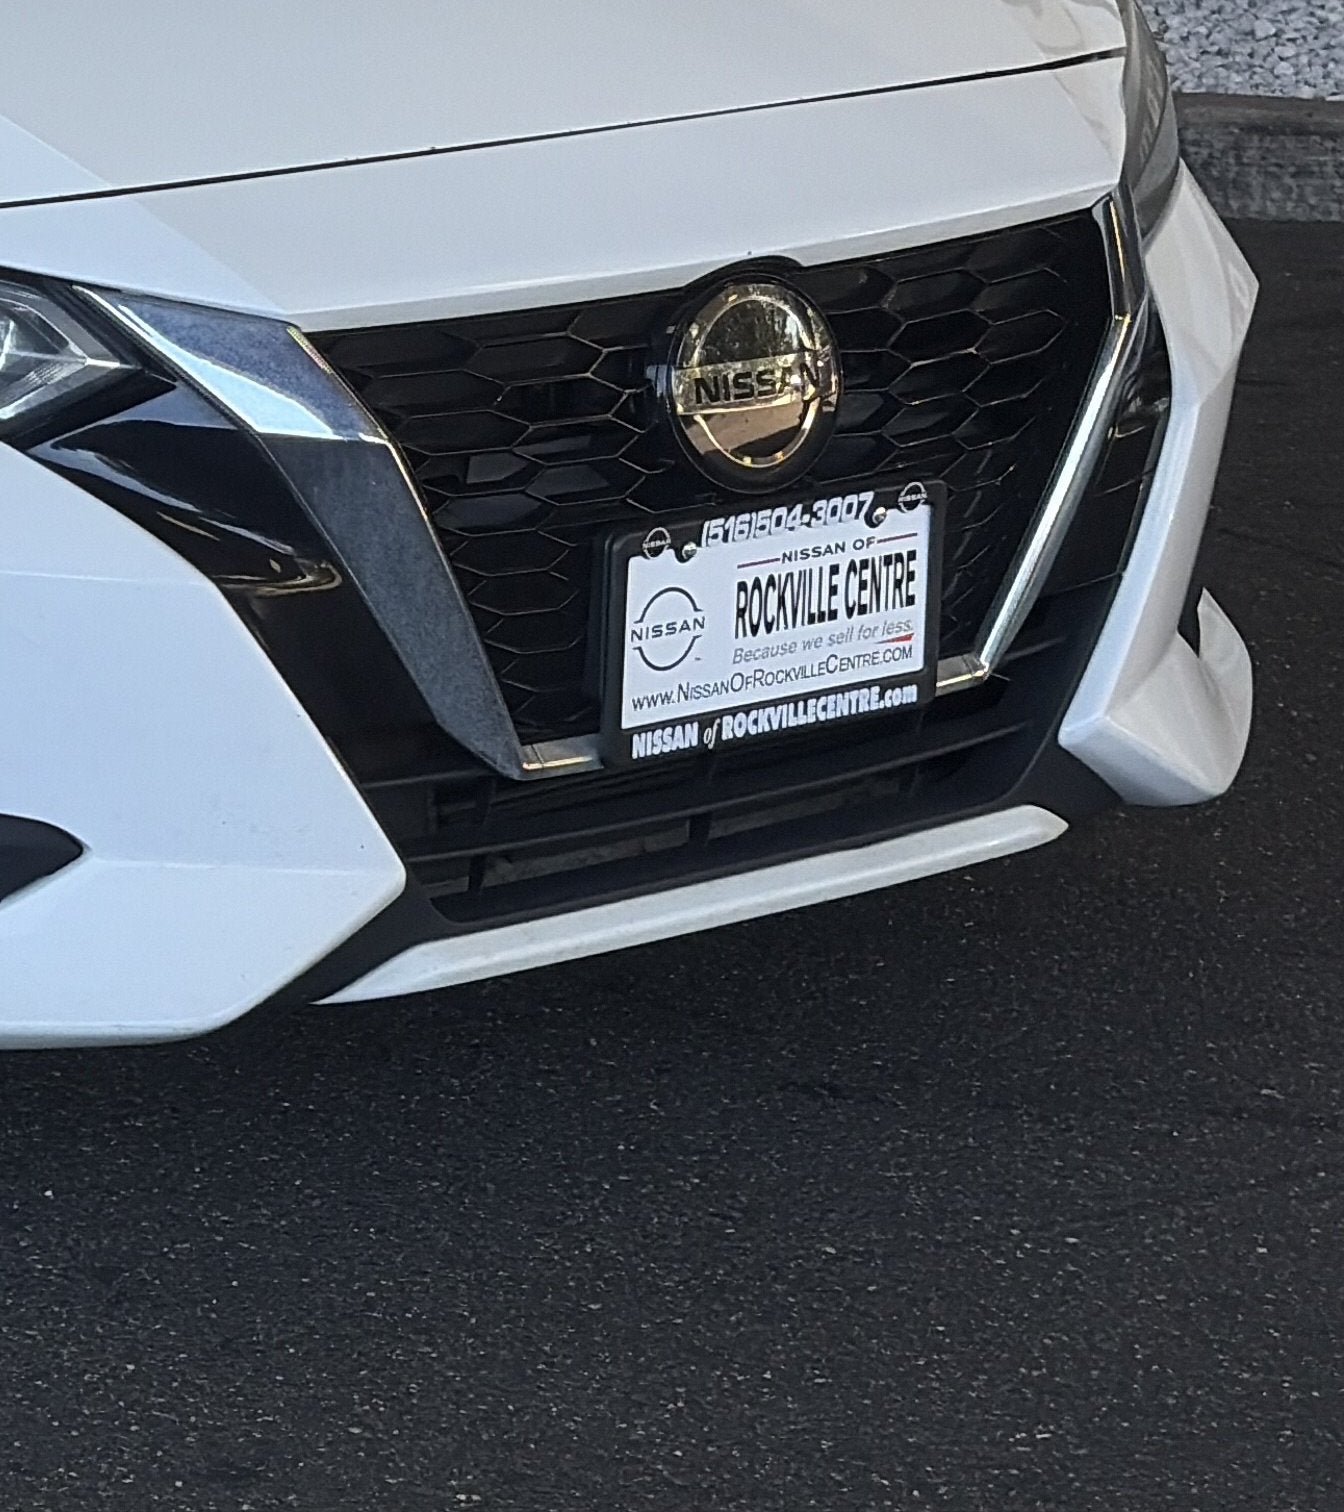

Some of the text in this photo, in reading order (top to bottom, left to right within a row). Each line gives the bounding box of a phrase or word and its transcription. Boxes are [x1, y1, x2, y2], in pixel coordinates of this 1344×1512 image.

[693, 362, 820, 405] NISSAN
[701, 491, 875, 548] (516)504-3007
[781, 536, 877, 564] NISSAN OF
[734, 549, 917, 639] ROCKVILLE CENTRE
[630, 615, 706, 644] NISSAN
[732, 618, 914, 665] Because we sell for less.
[631, 684, 918, 760] NISSAN of ROCKVILLECENTRE.com
